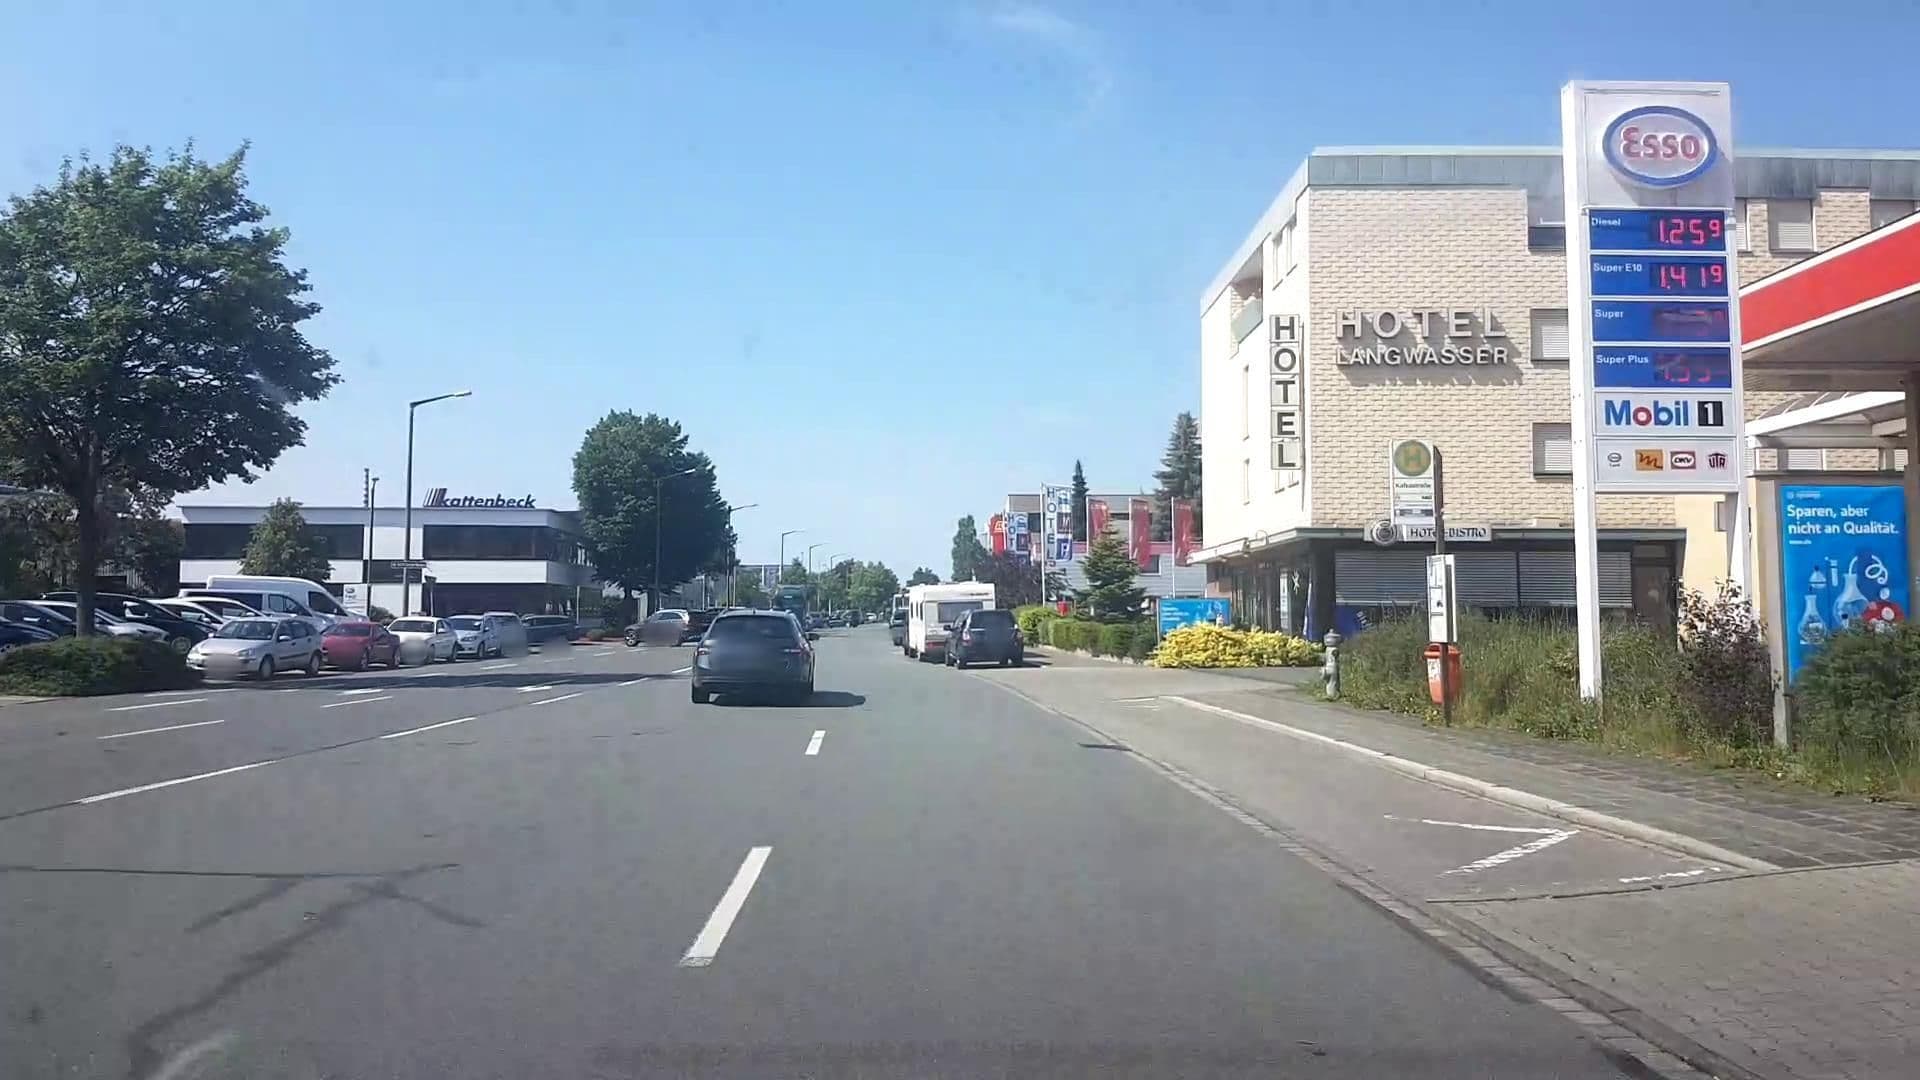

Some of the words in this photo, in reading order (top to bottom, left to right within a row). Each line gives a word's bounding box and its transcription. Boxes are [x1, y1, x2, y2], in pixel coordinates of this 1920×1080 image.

[1622, 126, 1700, 159] Esso
[1592, 217, 1621, 226] Diesel
[1593, 263, 1623, 273] Super
[1626, 263, 1643, 272] E10
[1594, 309, 1624, 319] Super
[1335, 308, 1506, 338] HOTEL
[1336, 346, 1508, 366] LANGWASSER
[1596, 355, 1625, 365] Super
[1628, 355, 1649, 364] Plus
[1274, 316, 1297, 467] HOTEL
[1604, 400, 1689, 426] Mobil
[1787, 504, 1837, 519] Sparen,
[1840, 504, 1869, 517] aber
[1410, 527, 1486, 538] HOT-BISTRO
[1788, 522, 1822, 534] nicht
[1824, 525, 1840, 534] an
[1843, 522, 1899, 535] Qualität.
